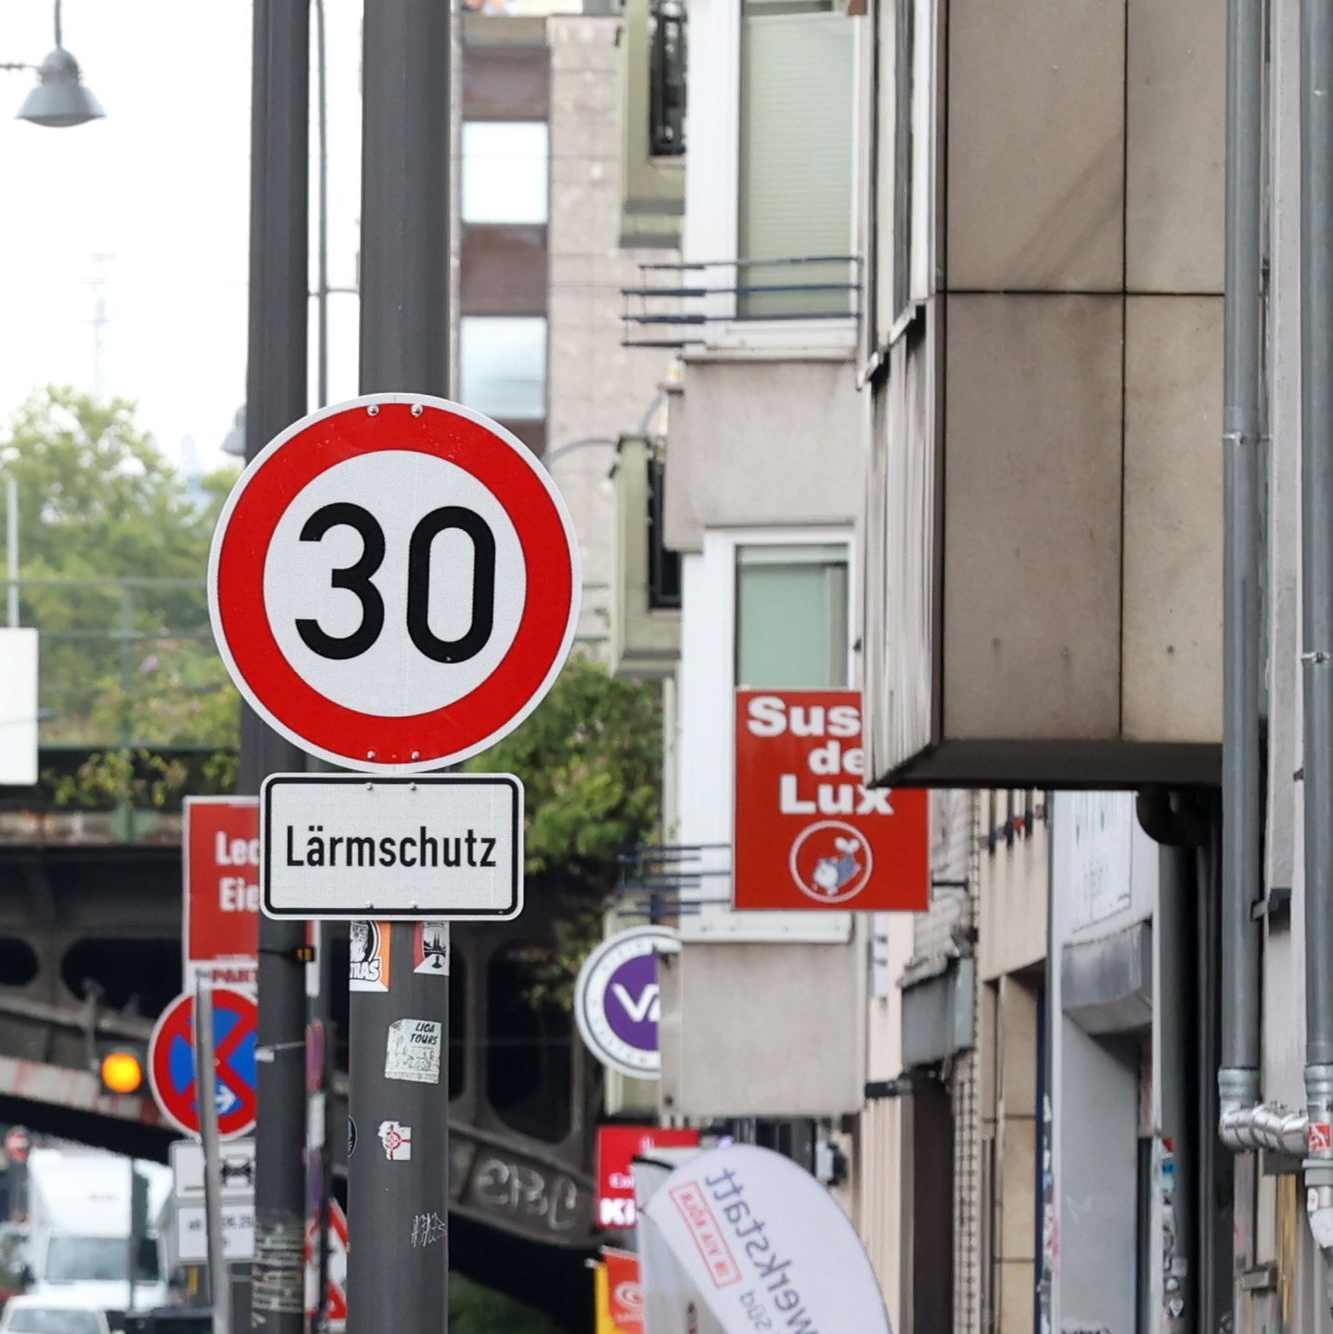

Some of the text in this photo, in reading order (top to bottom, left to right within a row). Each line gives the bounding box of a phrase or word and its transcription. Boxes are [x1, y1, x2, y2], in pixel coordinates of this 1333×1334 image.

[295, 502, 496, 664] 30
[746, 696, 862, 738] Sus
[779, 773, 895, 815] Lux
[286, 824, 497, 868] Lärmschutz
[410, 1033, 438, 1046] TOURS
[415, 1022, 437, 1034] LIGA
